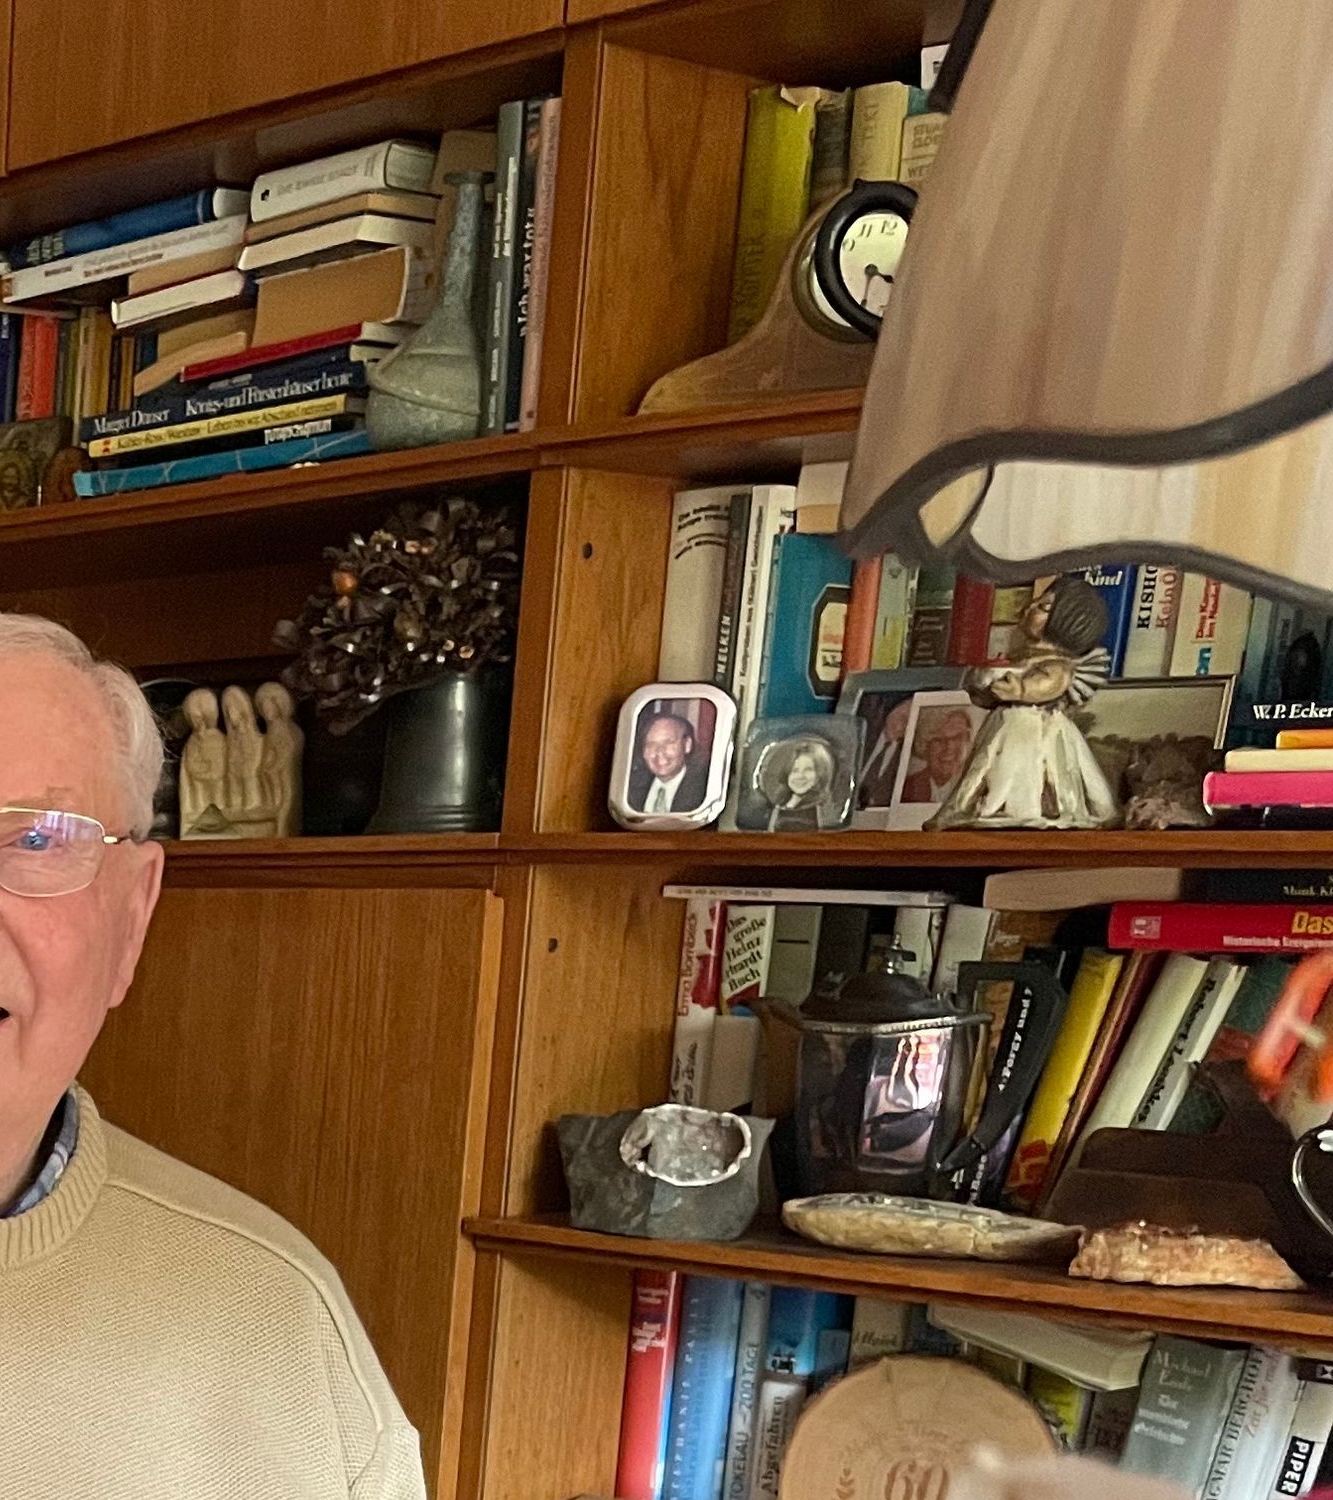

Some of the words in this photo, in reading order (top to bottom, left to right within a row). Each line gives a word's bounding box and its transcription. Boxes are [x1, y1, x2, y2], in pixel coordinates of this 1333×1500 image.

[717, 614, 732, 675] NELKEN
[1253, 704, 1271, 720] W.
[1273, 703, 1286, 720] P.
[682, 911, 698, 973] Bombeck
[734, 918, 766, 942] große
[1292, 911, 1333, 934] Das
[726, 937, 761, 962] Heinz
[677, 975, 692, 1017] Erma
[729, 967, 761, 992] Buch
[1001, 1030, 1023, 1077] Porgy
[1016, 1000, 1031, 1029] und
[729, 1430, 750, 1500] TOKELAU
[1281, 1439, 1310, 1496] PIPER
